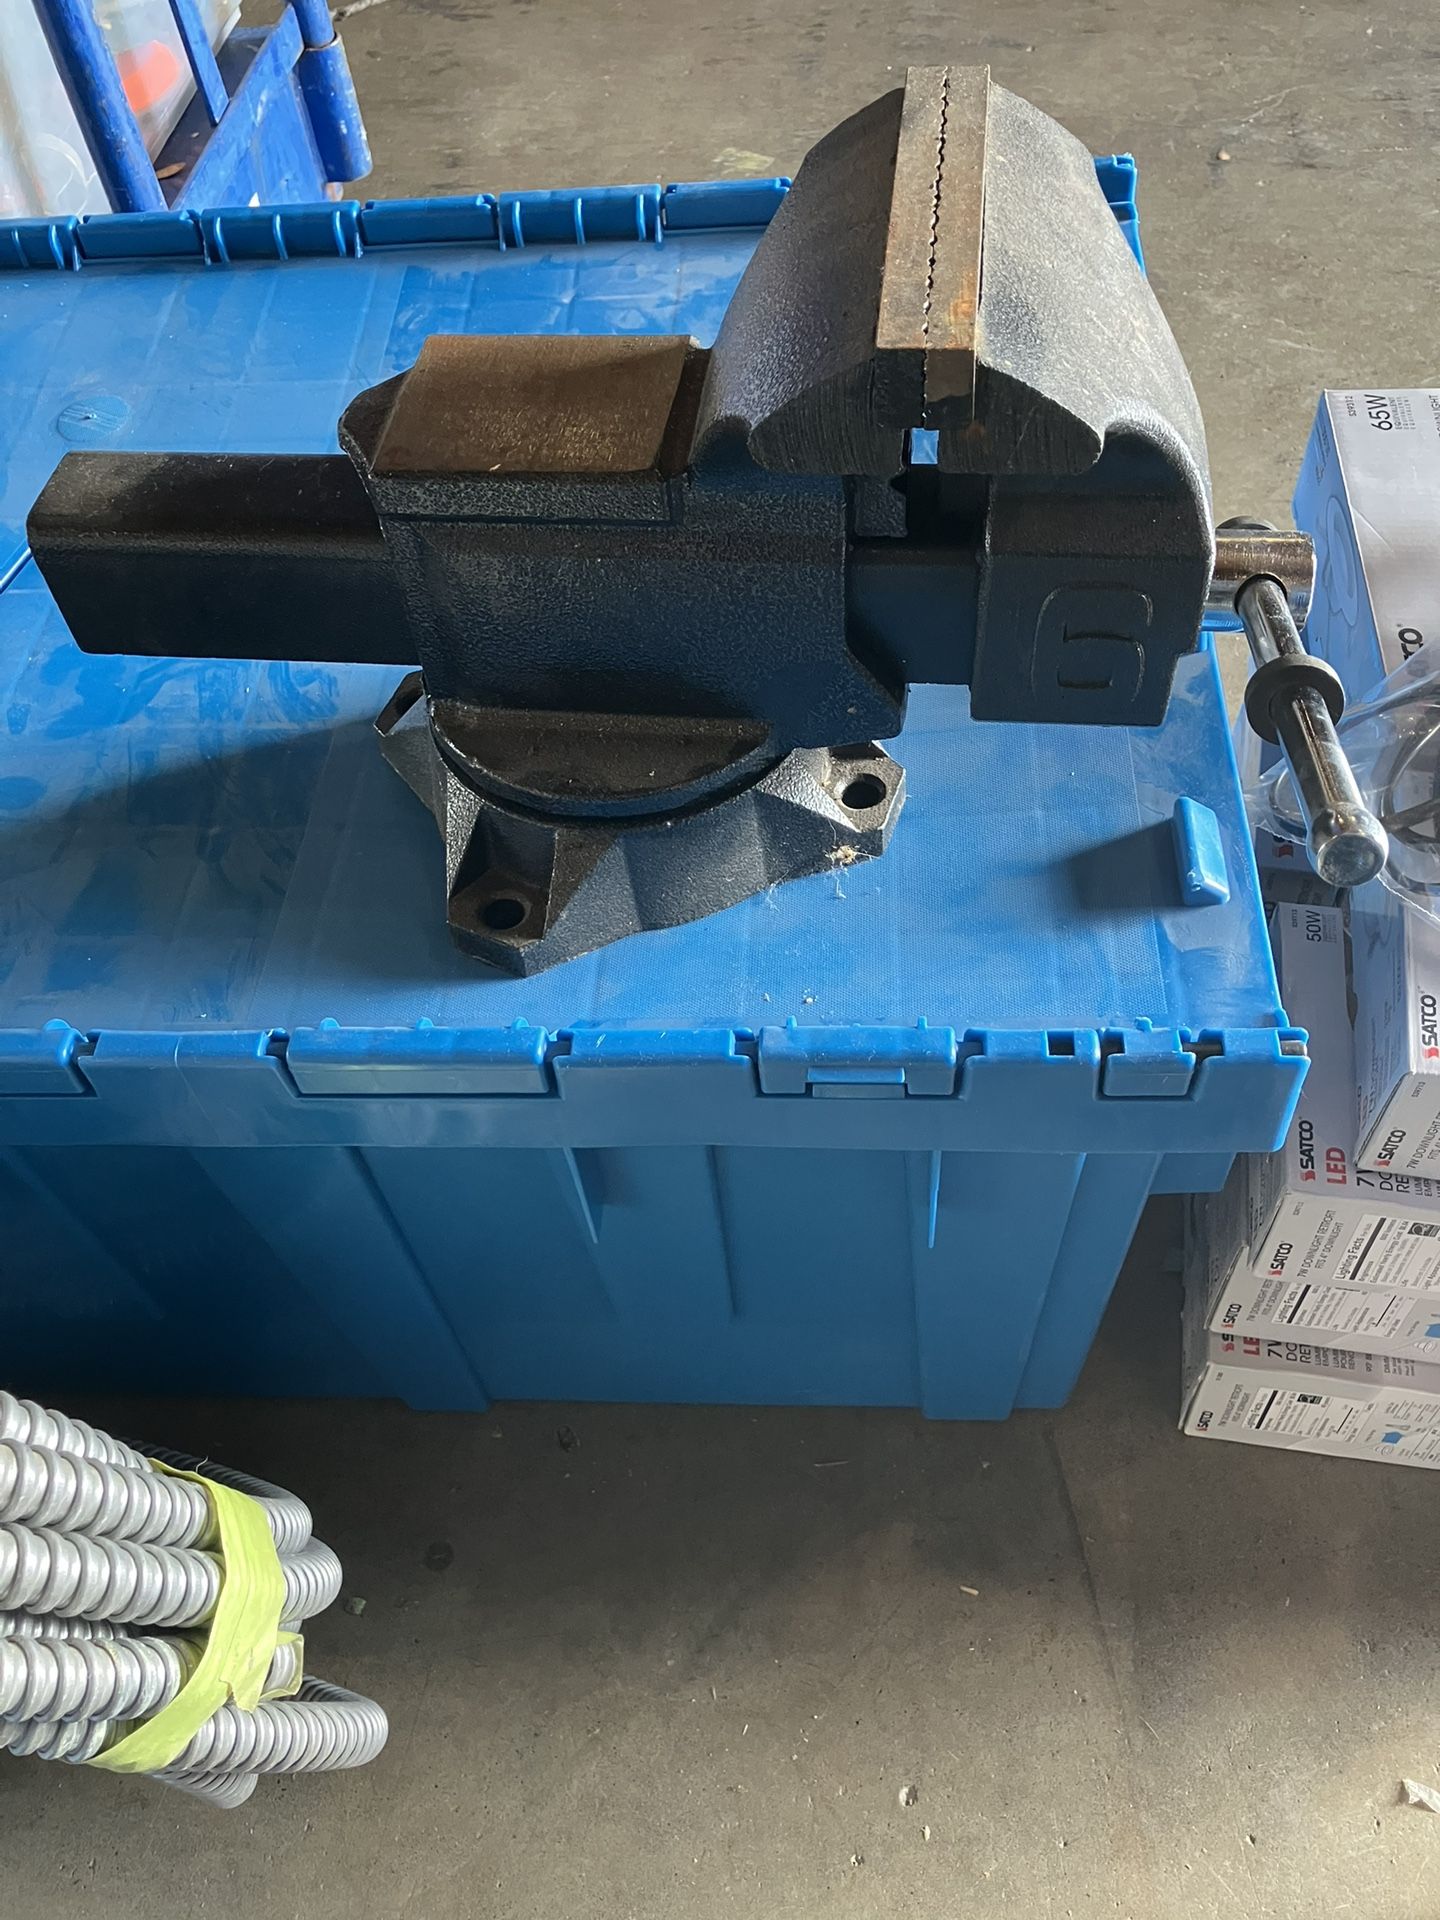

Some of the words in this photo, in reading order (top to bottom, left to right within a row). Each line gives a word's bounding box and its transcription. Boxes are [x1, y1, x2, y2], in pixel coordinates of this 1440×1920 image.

[1364, 394, 1393, 431] 65W
[1305, 909, 1321, 942] 50W
[1420, 994, 1438, 1047] SATCO
[1298, 1120, 1315, 1170] SATCO
[1377, 1129, 1407, 1160] SATCO
[1412, 1120, 1440, 1159] DOWNLIGHT
[1325, 1147, 1347, 1185] LED
[1301, 1234, 1326, 1268] DOWNLIGHT
[1322, 1221, 1344, 1253] DOWNLIGHT
[1270, 1243, 1293, 1270] SATCO
[1296, 1267, 1309, 1278] 7W
[1335, 1254, 1358, 1280] Lighting
[1348, 1237, 1365, 1254] Facts
